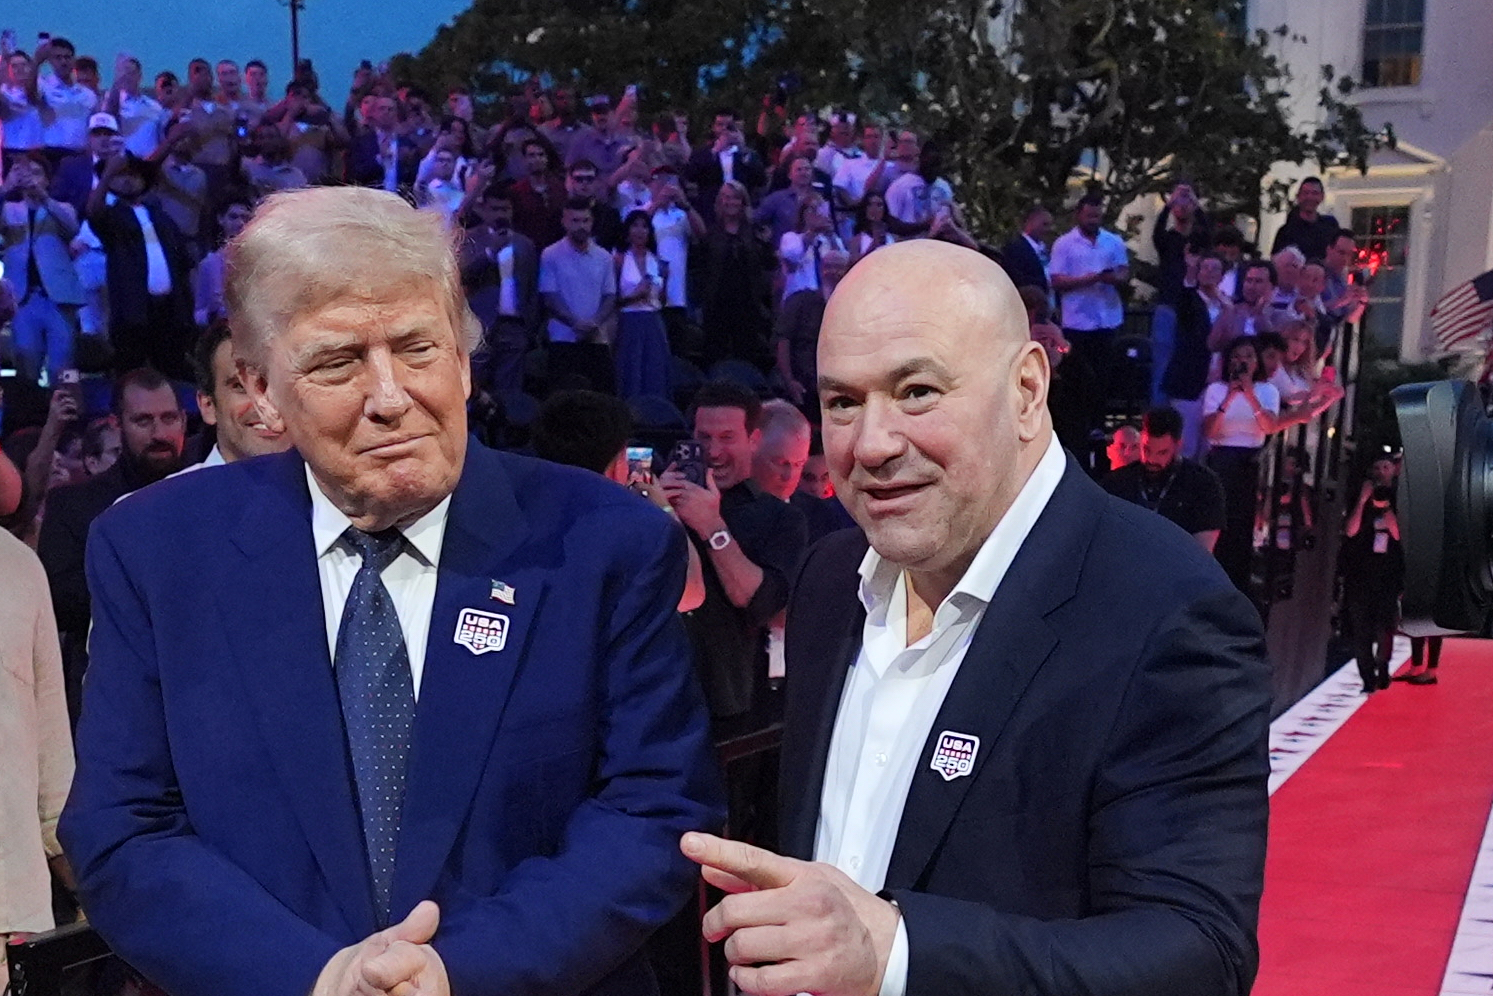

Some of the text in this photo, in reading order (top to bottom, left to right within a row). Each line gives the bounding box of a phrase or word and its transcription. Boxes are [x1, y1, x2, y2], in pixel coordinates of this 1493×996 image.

[464, 613, 502, 631] USA
[459, 630, 501, 647] 250
[942, 737, 972, 753] USA
[935, 755, 970, 772] 250
